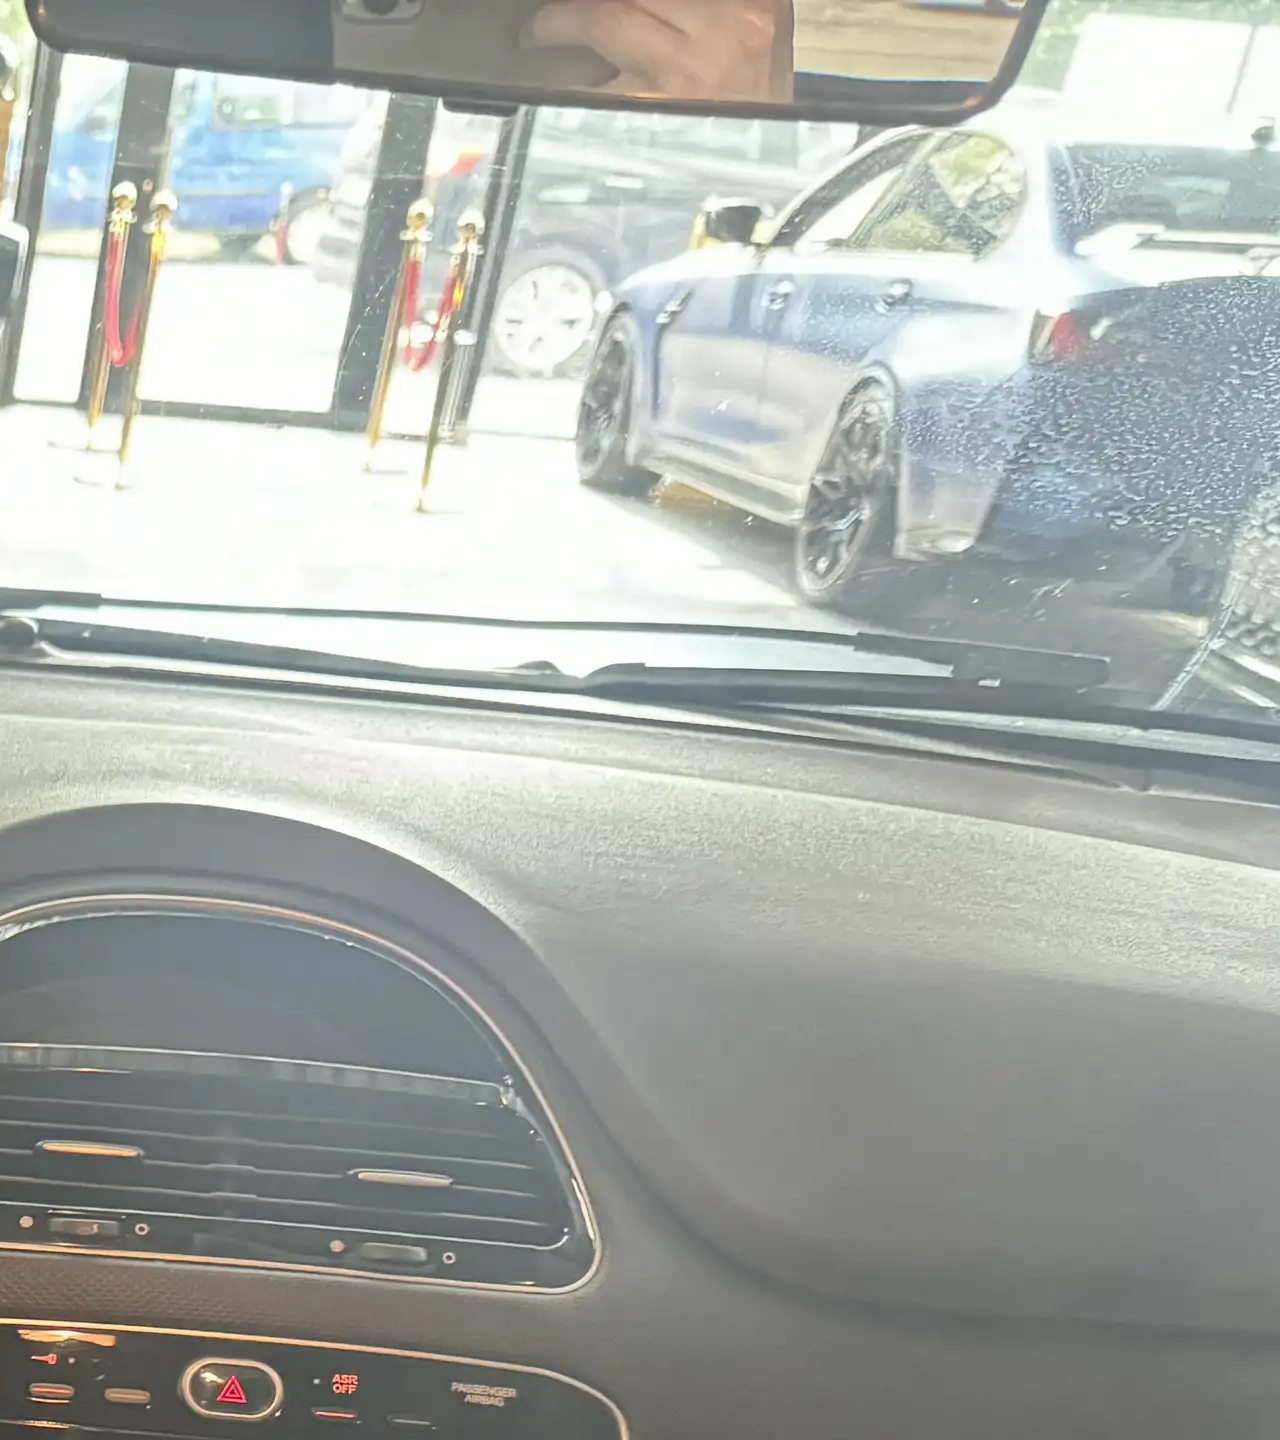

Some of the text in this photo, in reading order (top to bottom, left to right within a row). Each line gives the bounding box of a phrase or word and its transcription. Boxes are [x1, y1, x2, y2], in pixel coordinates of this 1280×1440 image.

[331, 1373, 359, 1386] ASR
[332, 1383, 358, 1395] OFF
[450, 1381, 517, 1398] PASSENGER
[463, 1393, 505, 1407] AIRBAG
